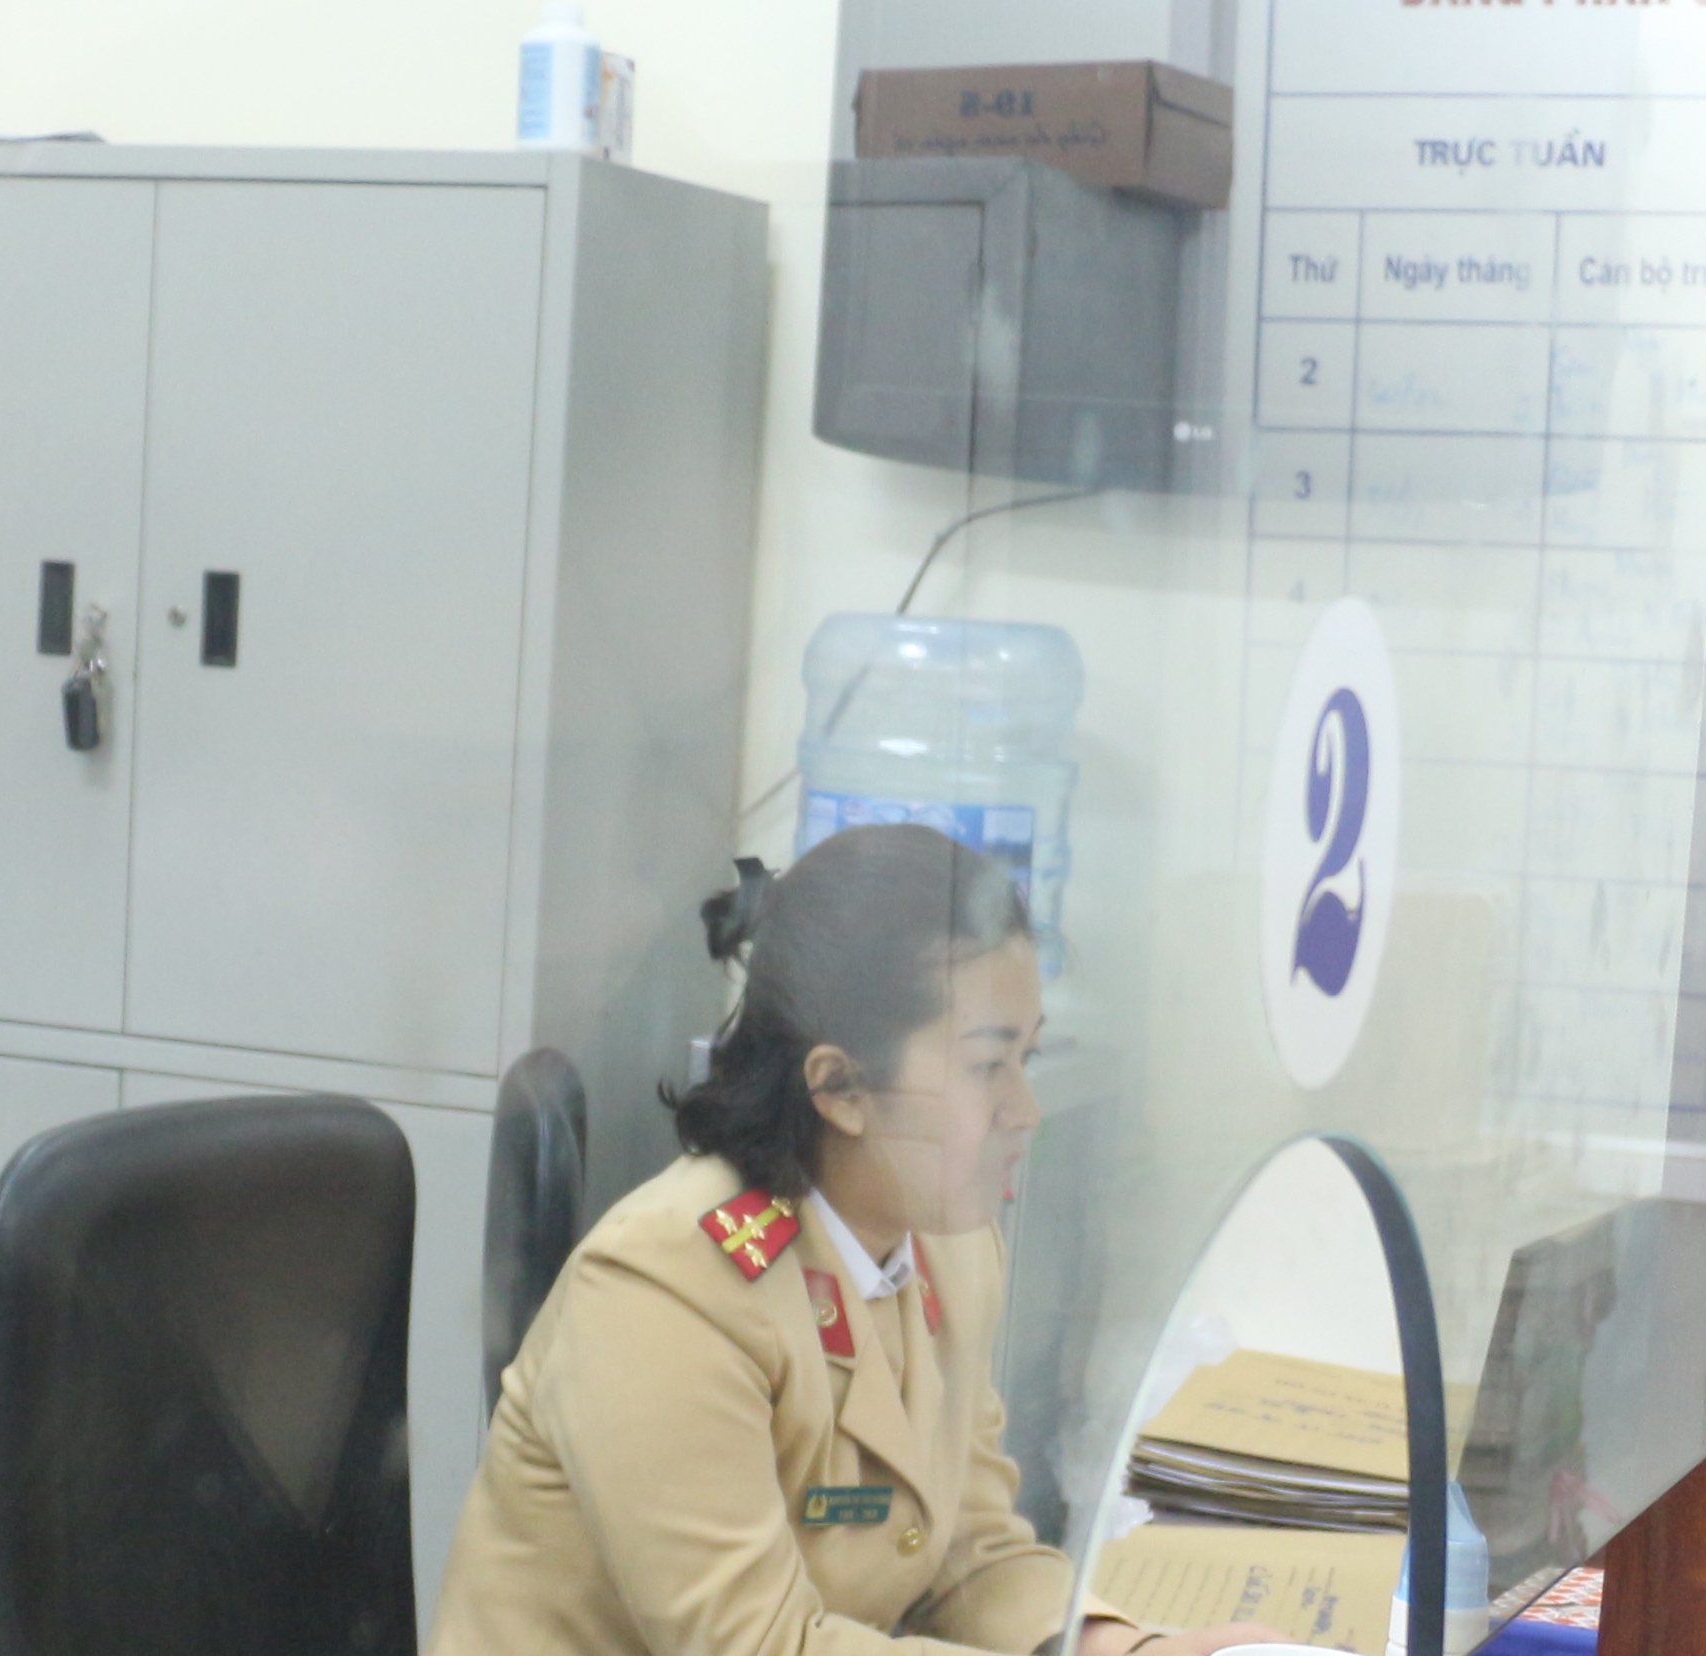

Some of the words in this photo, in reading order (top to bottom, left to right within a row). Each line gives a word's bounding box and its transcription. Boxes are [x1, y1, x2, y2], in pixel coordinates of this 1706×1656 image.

[1413, 137, 1495, 176] TRỰC
[1511, 129, 1606, 168] TUẦN
[1299, 357, 1319, 387] 2
[1295, 471, 1312, 500] 3
[1290, 687, 1370, 997] 2
